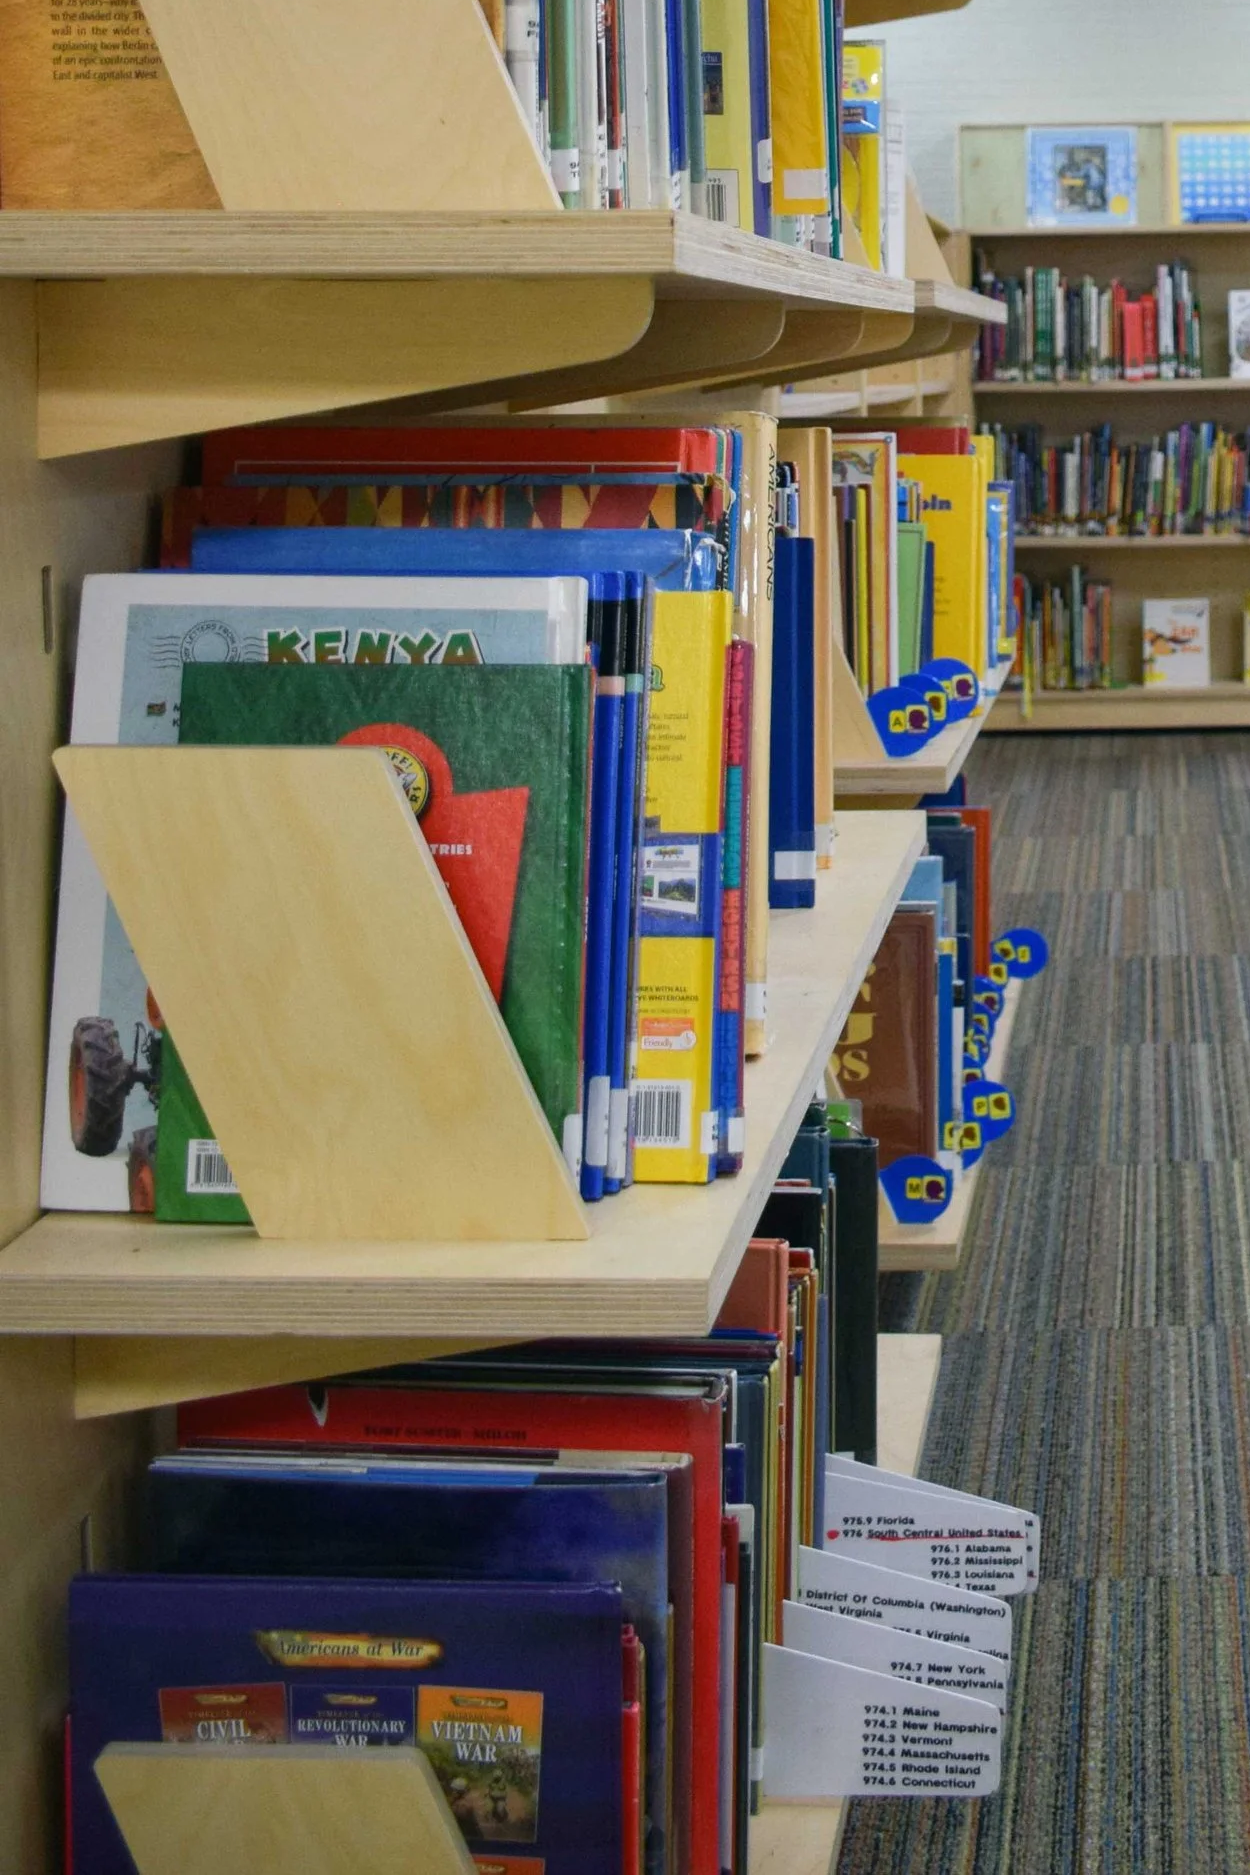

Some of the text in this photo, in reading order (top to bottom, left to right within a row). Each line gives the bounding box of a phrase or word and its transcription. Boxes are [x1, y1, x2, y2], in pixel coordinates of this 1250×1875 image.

[91, 26, 108, 35] the
[113, 26, 140, 35] wider
[766, 443, 776, 602] AMERICANS
[264, 626, 485, 665] KENYA
[430, 843, 473, 856] TRIES
[643, 1038, 673, 1048] Friendly
[842, 1516, 915, 1526] 975.9 Florida
[842, 1528, 1021, 1538] 976 South Central United States
[930, 1544, 1011, 1553] 976.1 Alabama
[930, 1556, 1023, 1567] 976.2 Mississippi
[931, 1570, 1015, 1579] 976.3 Louisiana
[966, 1583, 996, 1591] Texas
[806, 1590, 1007, 1618] District Of Columbia (Washington)
[838, 1605, 883, 1619] Virginia
[926, 1629, 971, 1643] Virginia
[277, 1638, 424, 1657] Americans at War
[890, 1662, 986, 1675] 974.7 New York
[927, 1677, 1004, 1690] Pennsylvania
[864, 1705, 940, 1717] 974.1 Maine
[196, 1719, 252, 1741] CIVIL
[297, 1719, 407, 1734] REVOLUTIONARY
[430, 1720, 523, 1744] VIETNAM
[863, 1719, 998, 1735] 974.2 New Hampshire
[334, 1734, 369, 1747] WAR
[862, 1734, 953, 1746] 974.3 Vermont
[455, 1742, 498, 1763] WAR
[862, 1747, 990, 1762] 974.4 Massachusetts
[863, 1762, 981, 1775] 974.5 Rhode Island
[863, 1776, 976, 1789] 974.6 Connecticut
